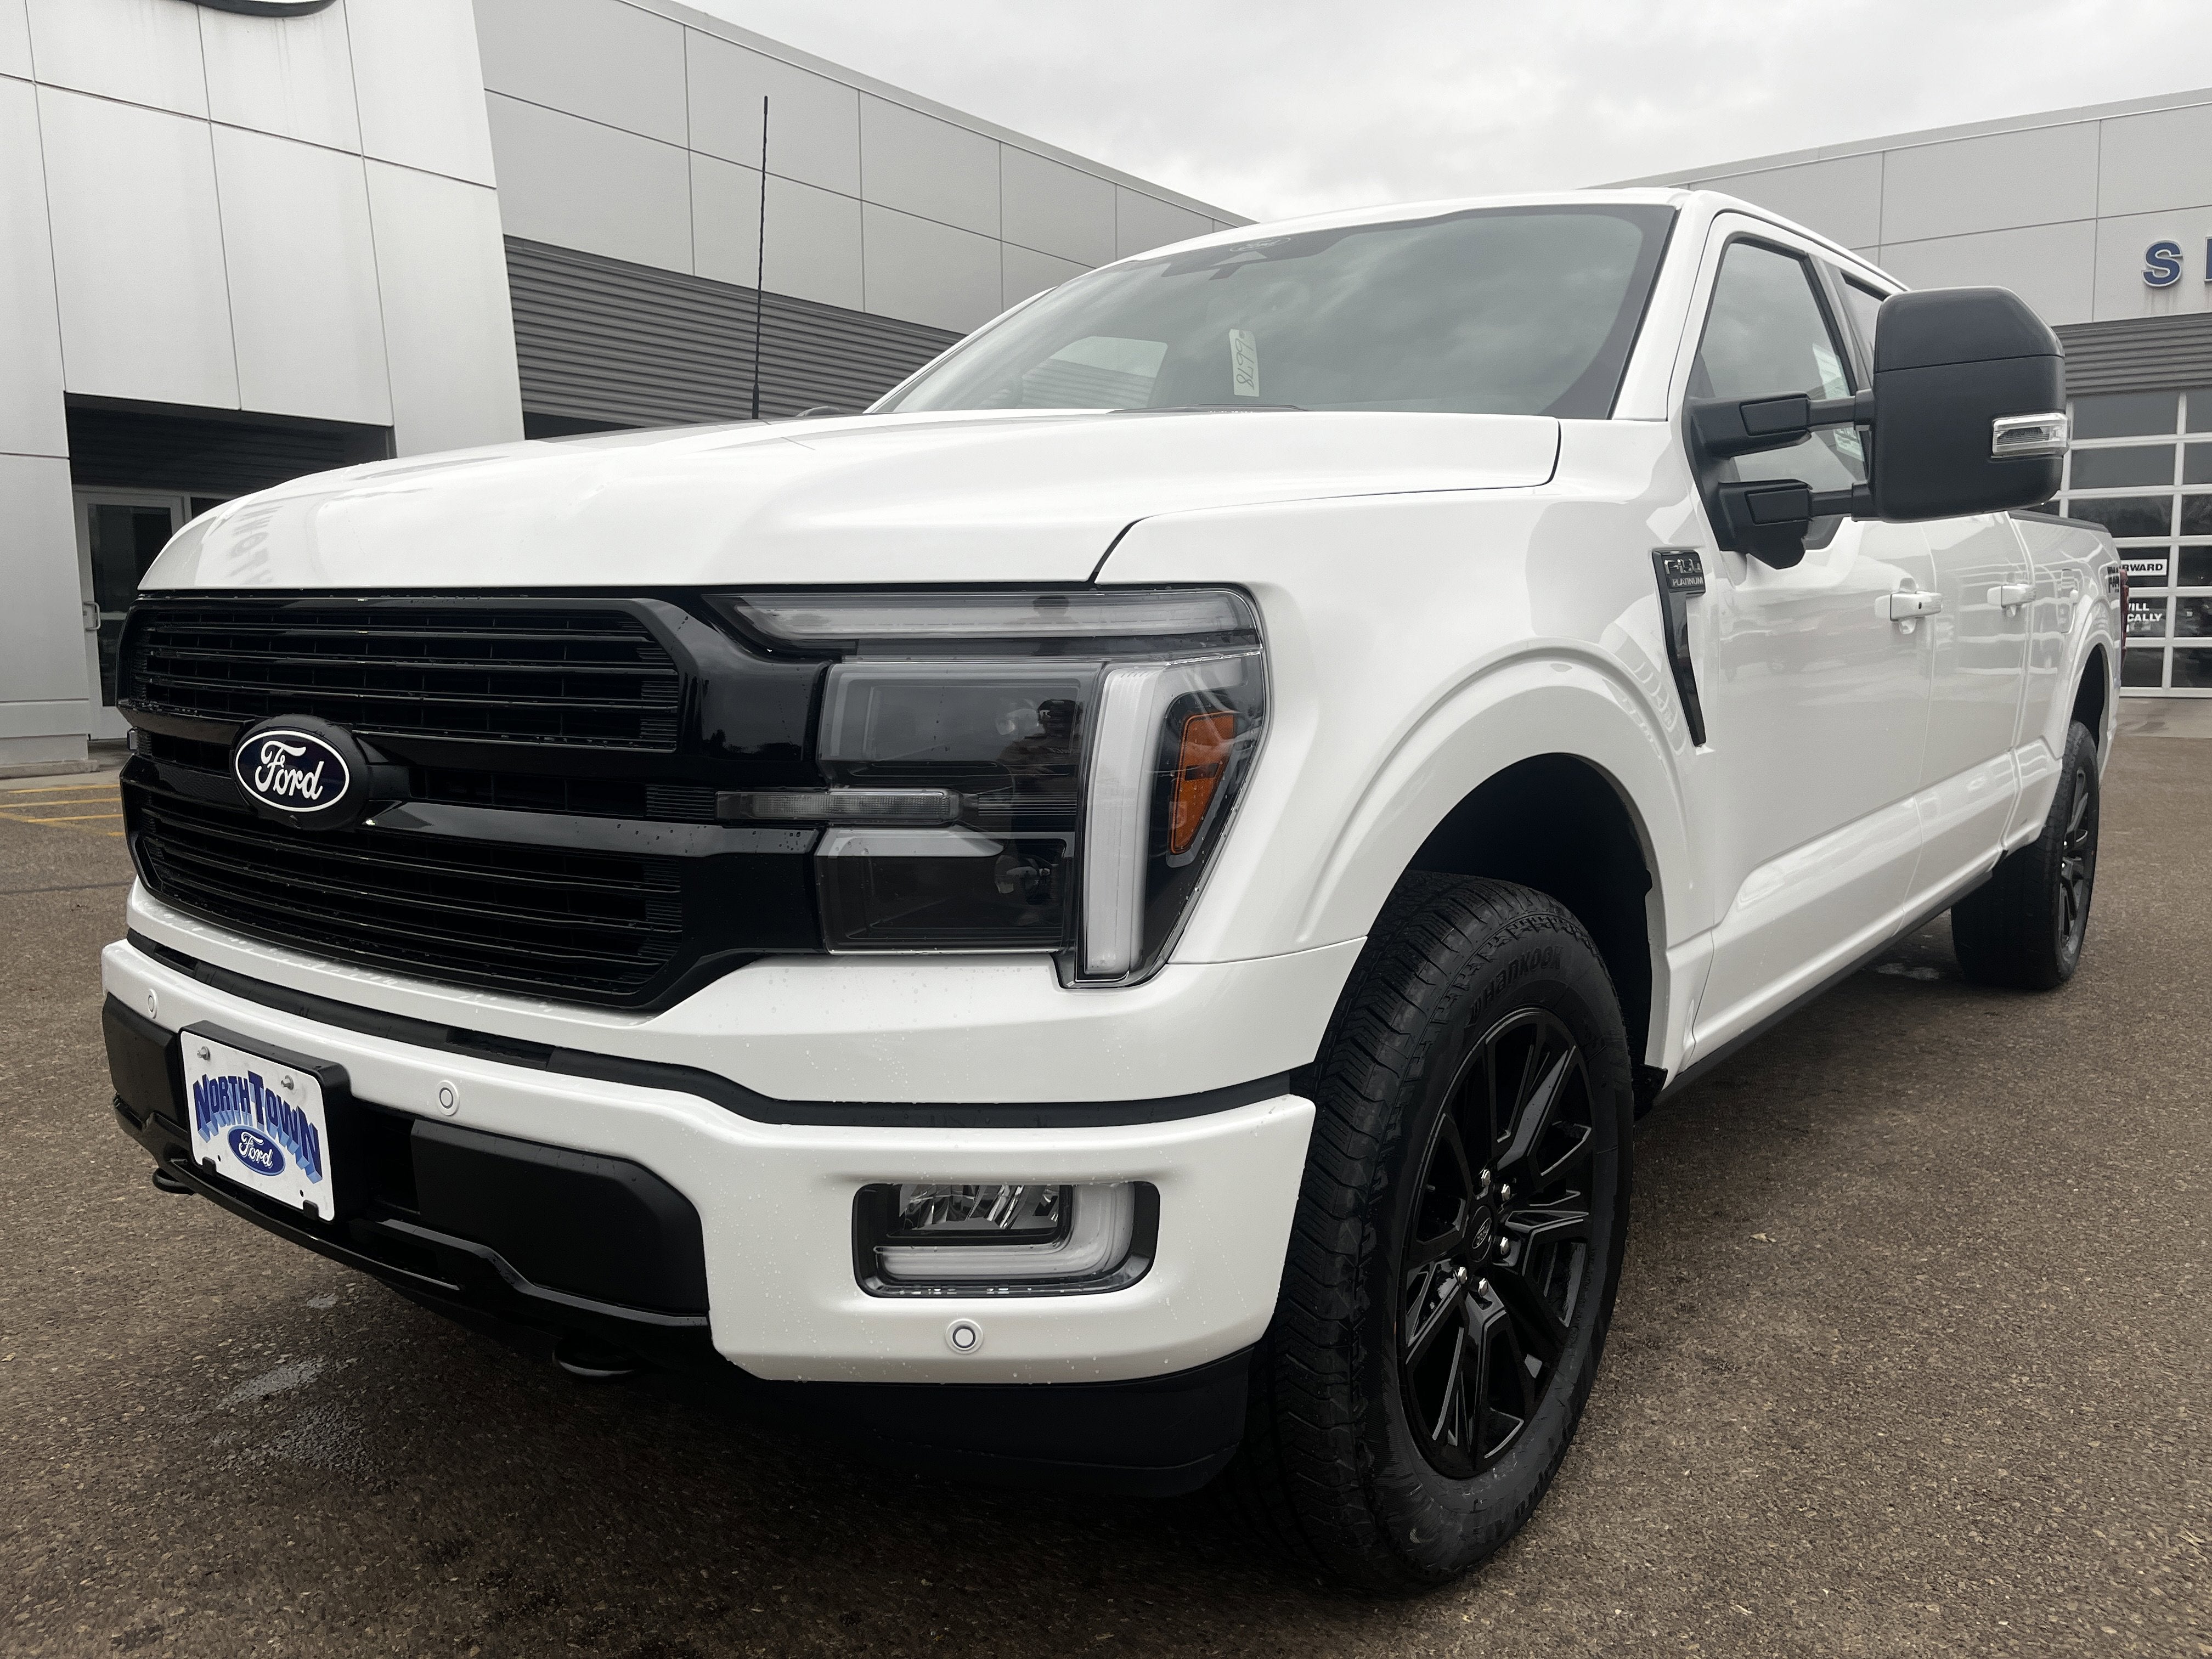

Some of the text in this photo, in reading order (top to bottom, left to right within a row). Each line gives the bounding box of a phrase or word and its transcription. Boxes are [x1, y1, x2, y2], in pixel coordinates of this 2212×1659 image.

[1235, 338, 1255, 391] 6678
[1672, 577, 1704, 586] PLATINUM
[255, 740, 325, 800] Ford
[239, 1131, 274, 1169] Ford
